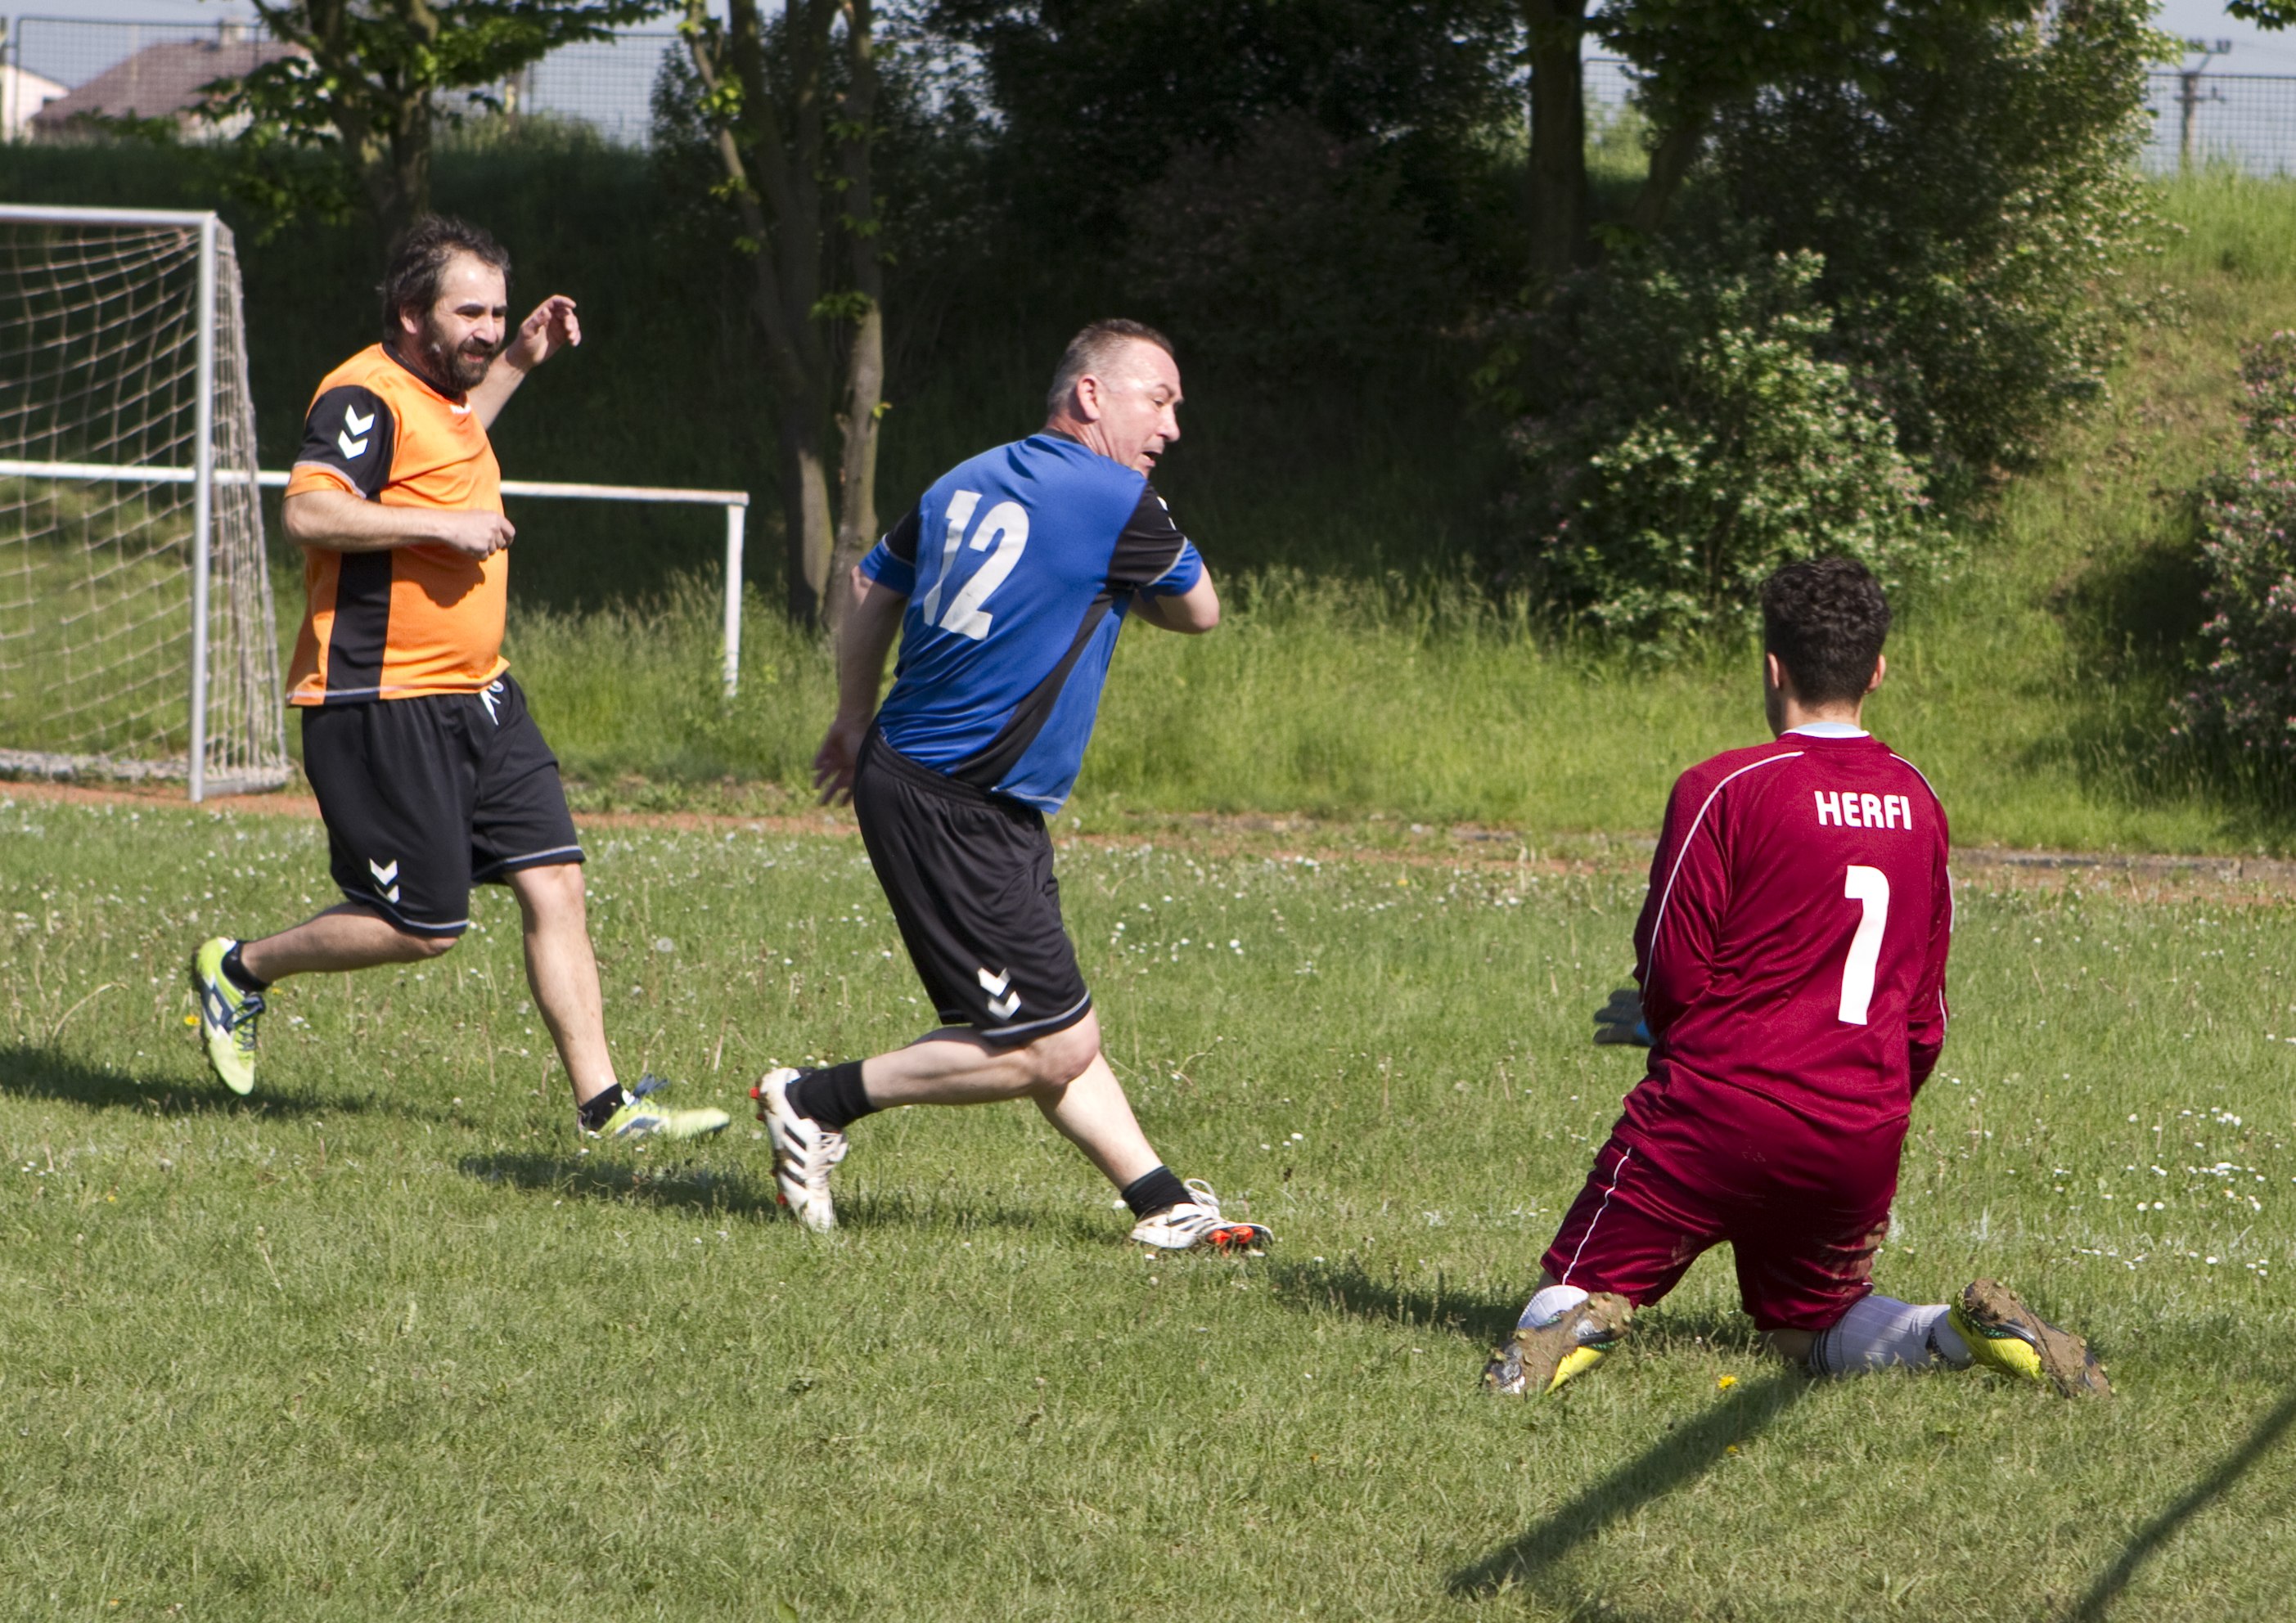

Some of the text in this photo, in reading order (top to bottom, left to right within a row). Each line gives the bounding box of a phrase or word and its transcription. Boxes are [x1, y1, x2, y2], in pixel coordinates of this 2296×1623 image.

[923, 489, 1029, 641] 12
[1814, 790, 1912, 830] HERFI
[1838, 865, 1890, 1026] 1
